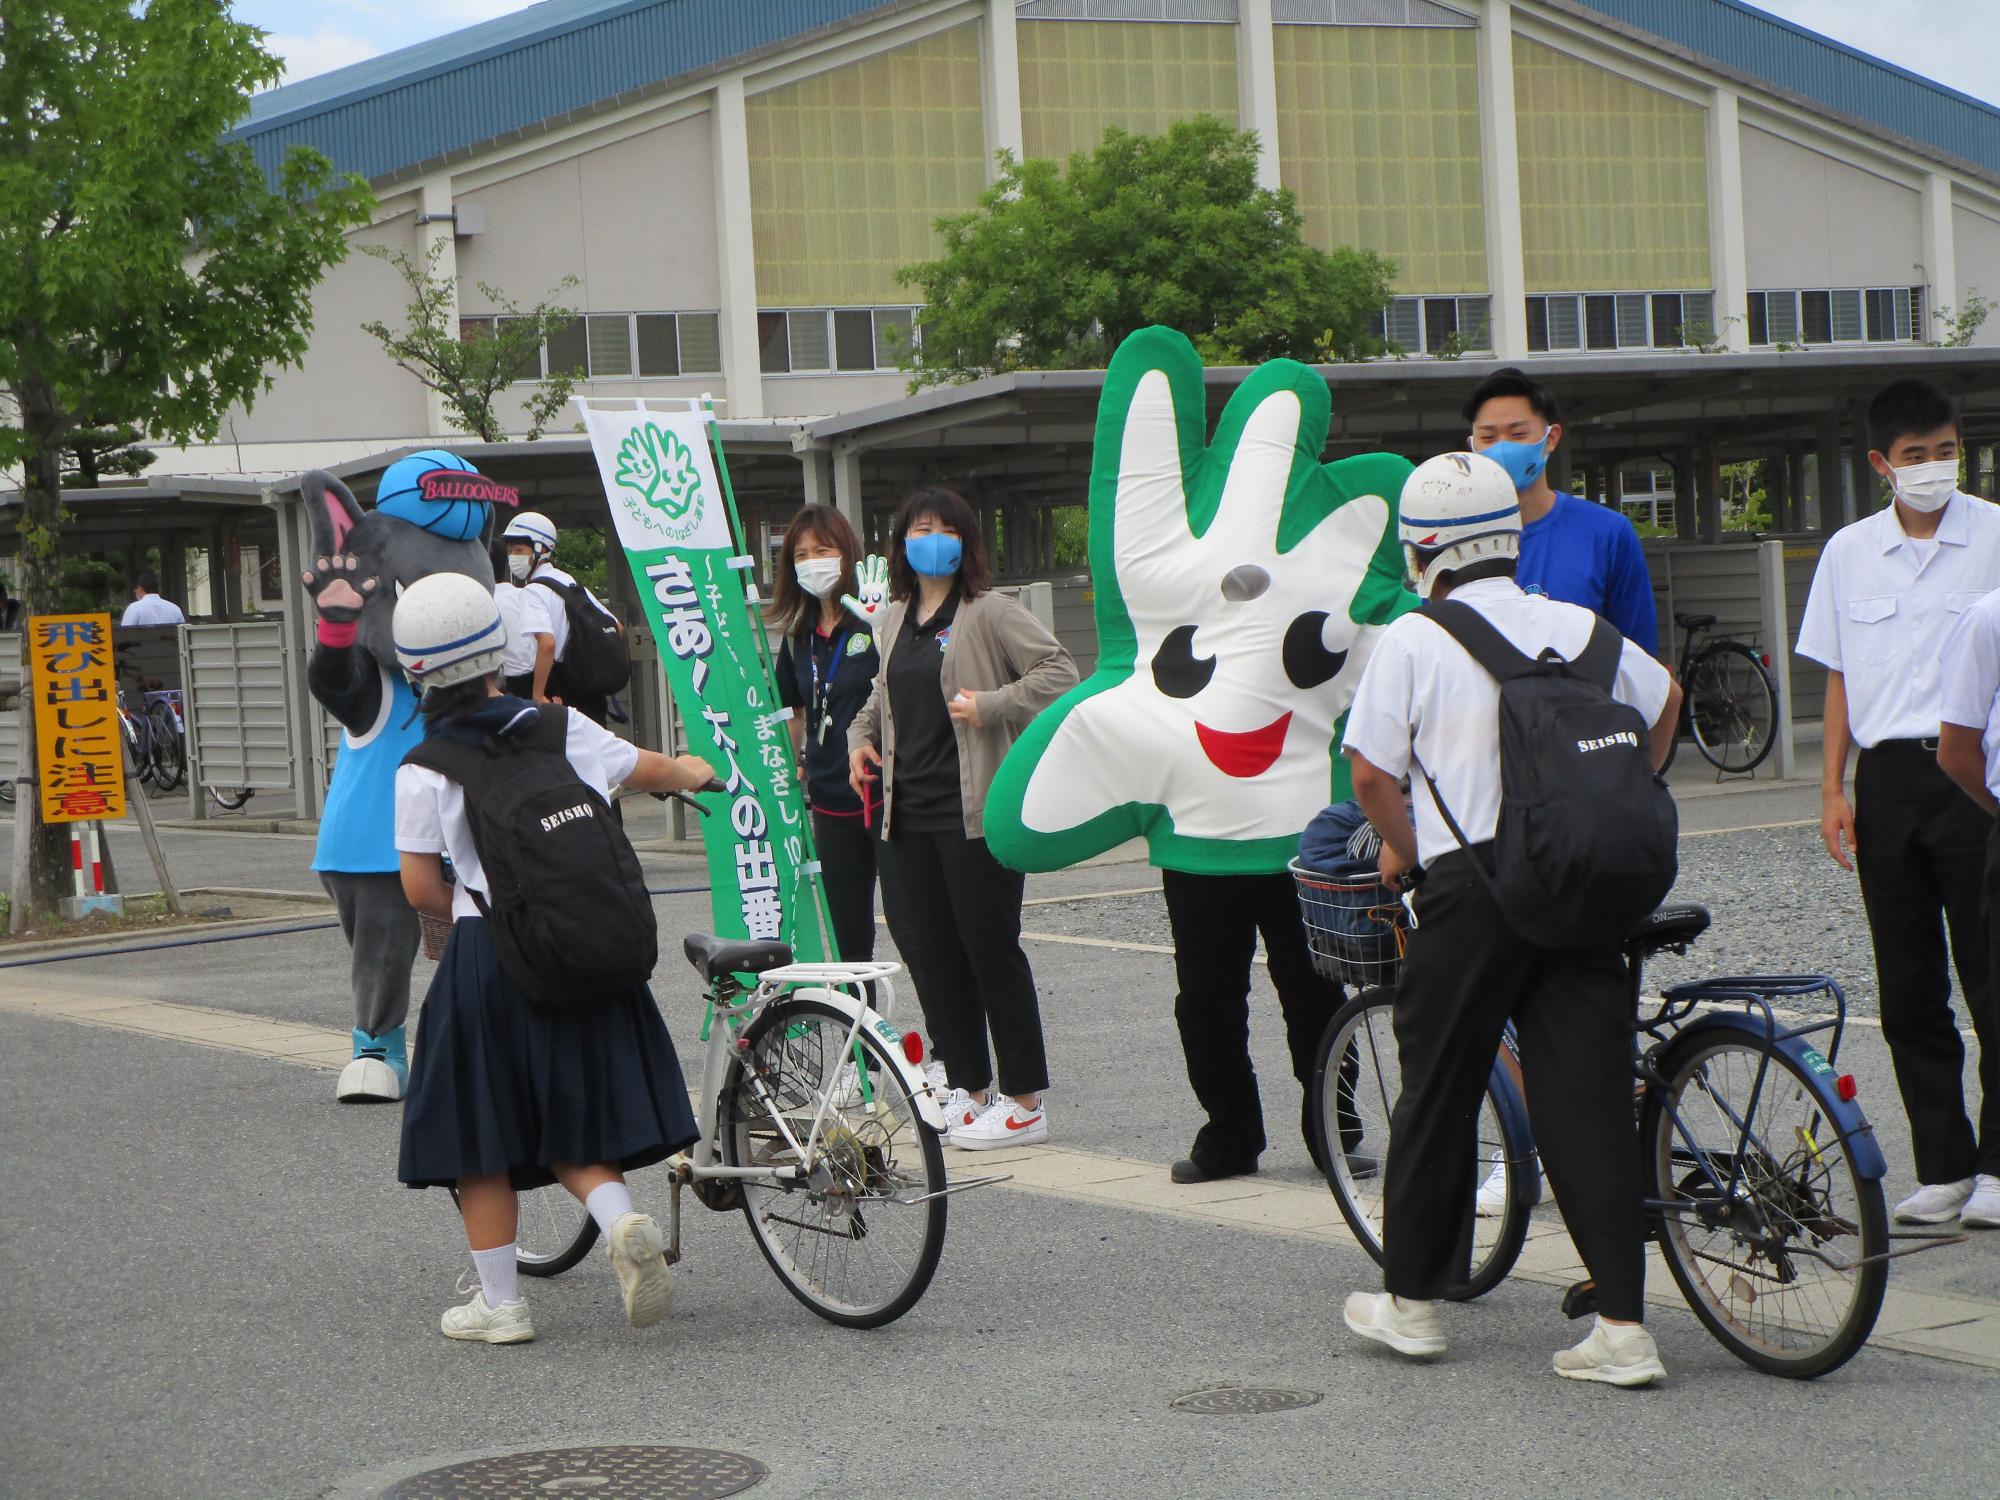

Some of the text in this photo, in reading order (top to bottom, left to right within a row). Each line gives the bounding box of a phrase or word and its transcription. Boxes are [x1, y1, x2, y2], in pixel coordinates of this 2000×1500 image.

[423, 479, 520, 507] BALLOONERS
[38, 619, 119, 816] 飛び出しに注意
[1577, 731, 1638, 753] SEISHO
[540, 803, 594, 832] SEISHO
